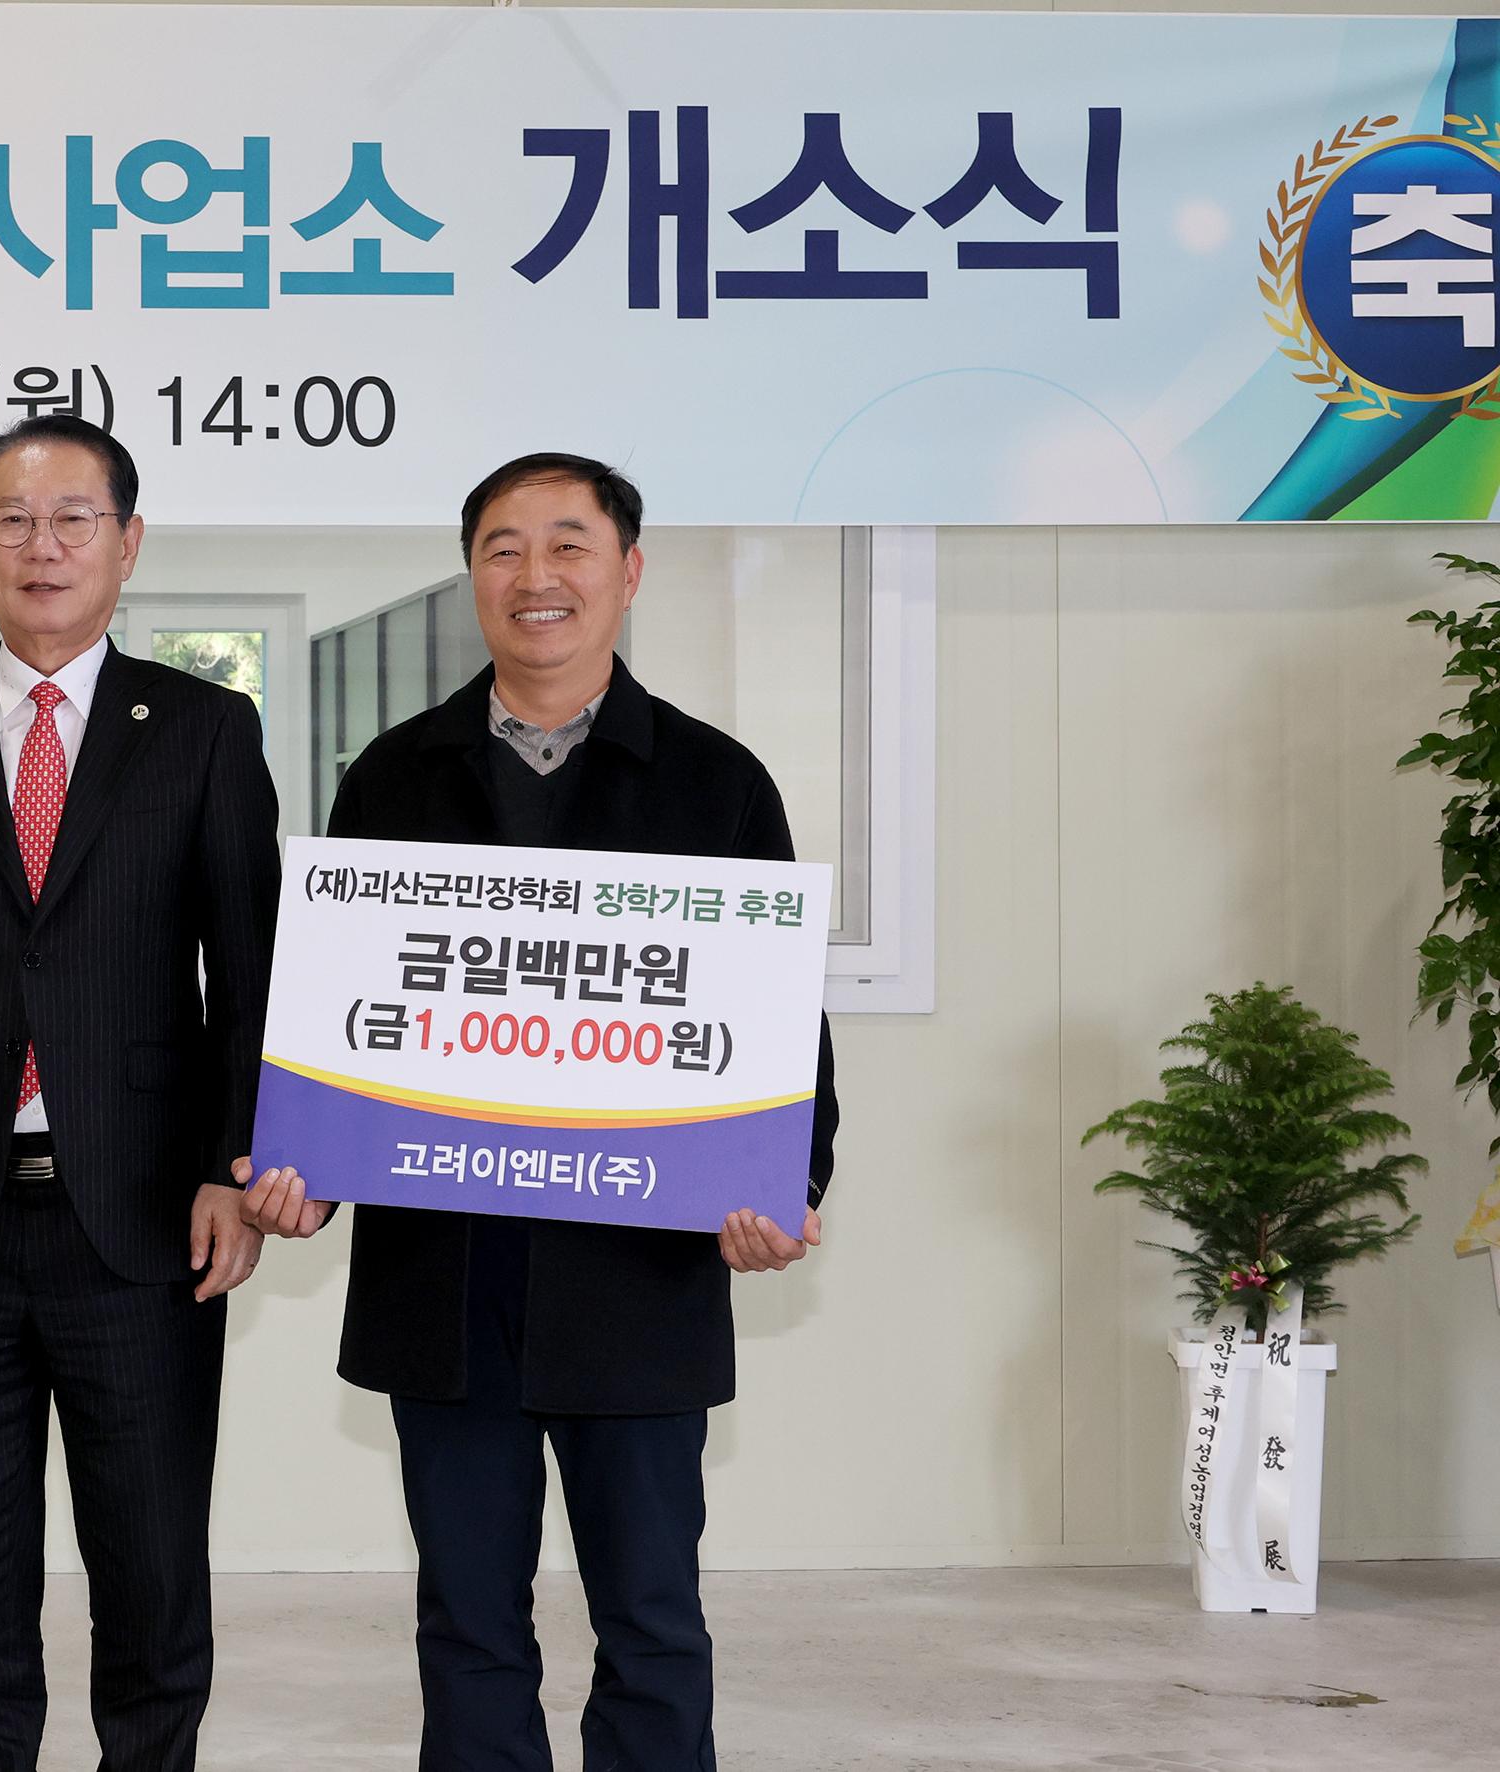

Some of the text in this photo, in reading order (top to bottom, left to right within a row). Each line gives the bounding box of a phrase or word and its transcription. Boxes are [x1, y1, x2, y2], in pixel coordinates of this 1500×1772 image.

[511, 106, 1121, 319] 개소식
[1351, 185, 1495, 347] 축
[158, 376, 396, 447] 14:00
[304, 865, 804, 926] (재)괴산군민장학회 장학기금 후원
[397, 932, 690, 1006] 금일백만원
[345, 998, 733, 1075] (금1,000,000원)
[390, 1142, 657, 1198] 고려이엔티(주)
[1188, 1325, 1237, 1551] 청안면 후계여성농업경영
